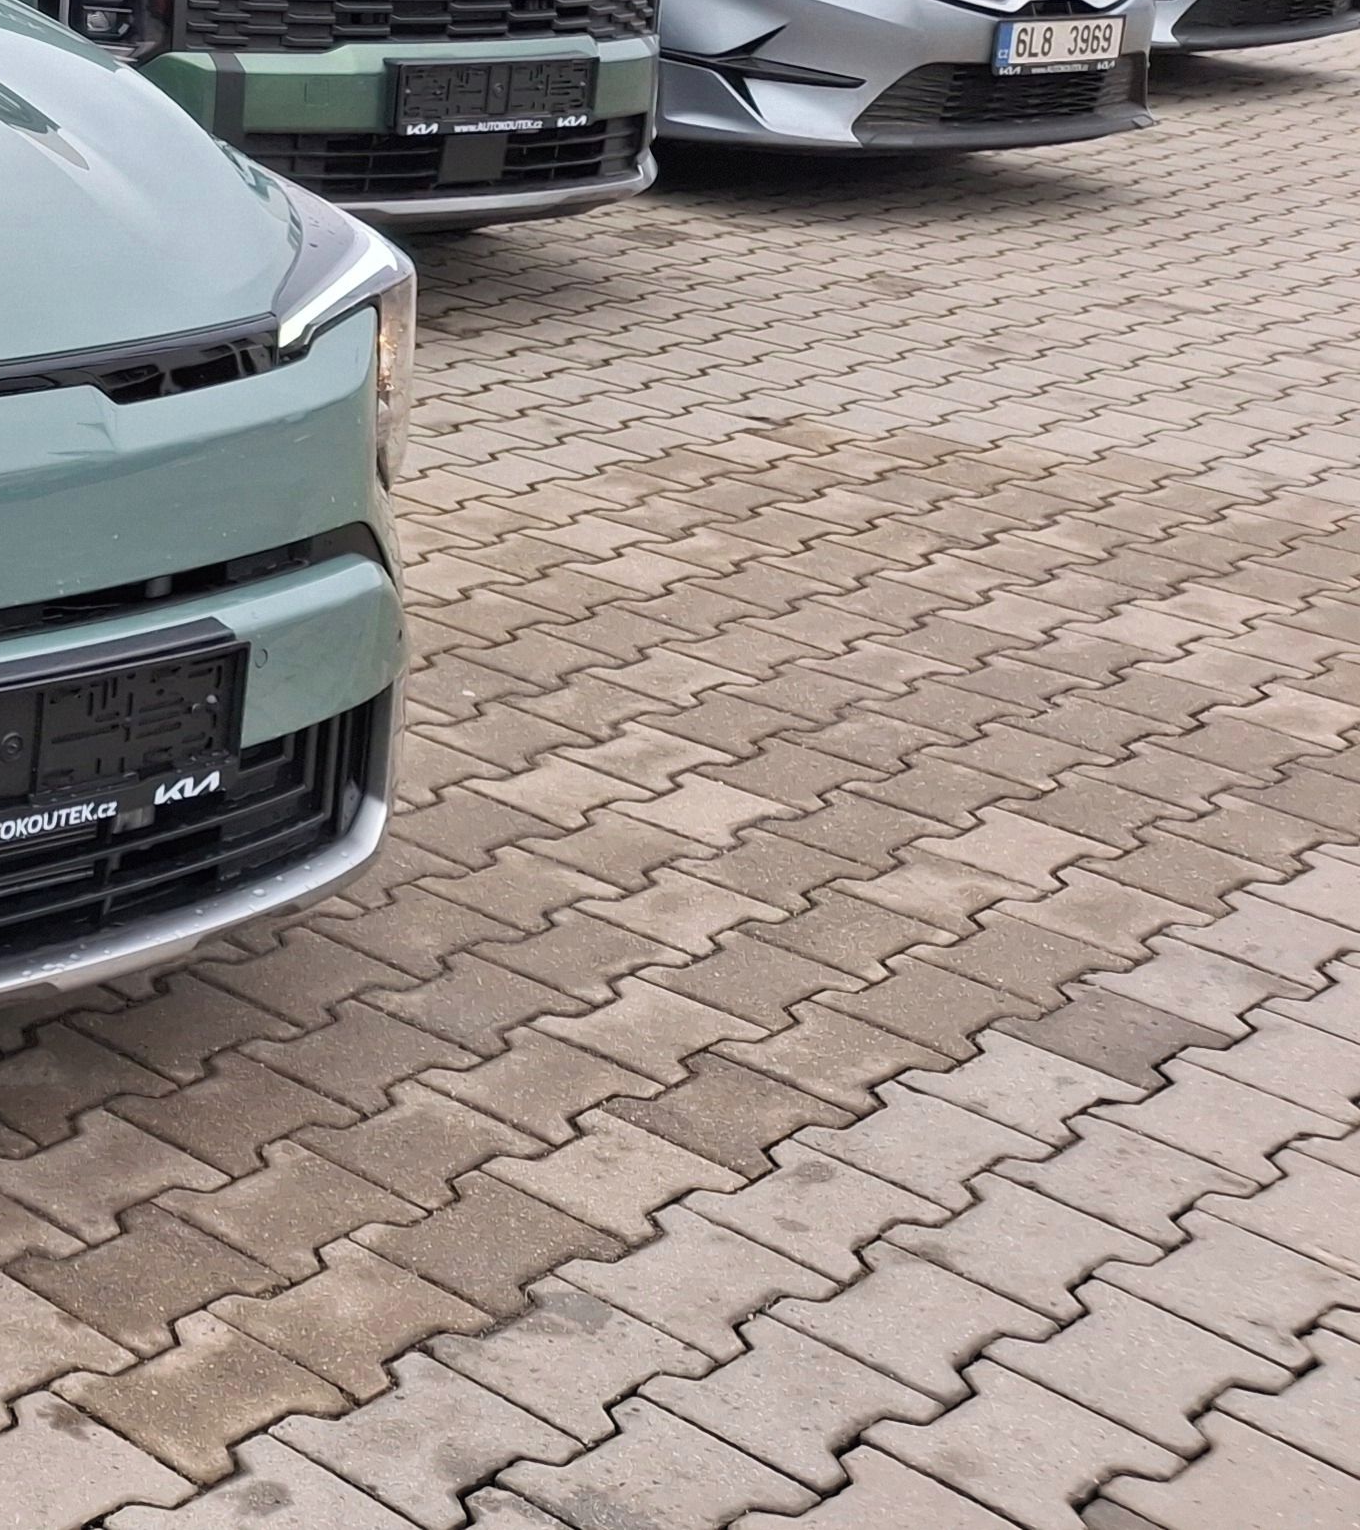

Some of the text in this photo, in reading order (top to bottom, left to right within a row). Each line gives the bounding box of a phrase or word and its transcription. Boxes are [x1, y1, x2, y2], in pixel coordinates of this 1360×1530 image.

[1015, 23, 1114, 58] 6L8 3969
[406, 122, 439, 136] KIA
[556, 114, 588, 128] KIA
[153, 770, 221, 806] KIA
